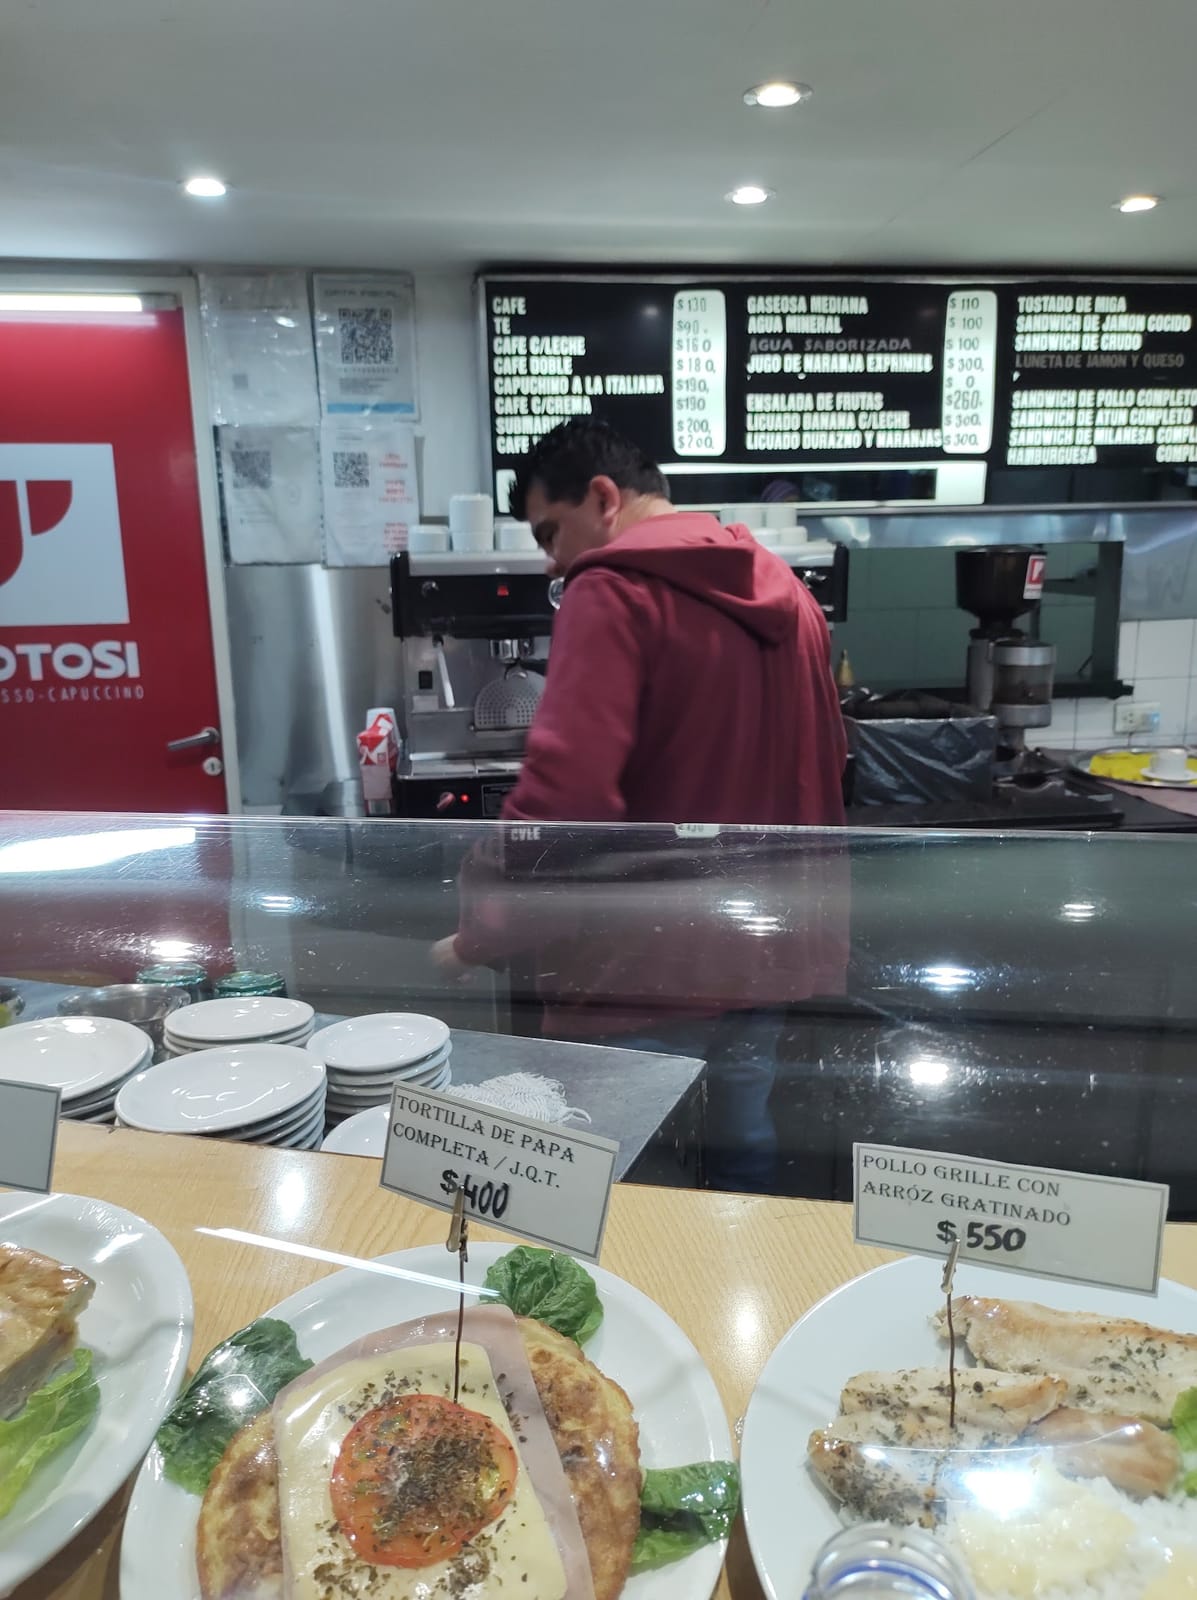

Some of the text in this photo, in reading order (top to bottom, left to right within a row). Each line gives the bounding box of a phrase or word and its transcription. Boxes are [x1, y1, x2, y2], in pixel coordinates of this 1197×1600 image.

[492, 297, 526, 315] CAFE
[748, 295, 868, 314] GASEOSA MEDIANA
[1017, 296, 1126, 313] TOSTADO DE MIGA
[493, 317, 511, 334] TE
[748, 315, 842, 334] AGUA MINERAL
[1016, 314, 1192, 332] SANDWICH DE JAMON COCIDO
[493, 336, 586, 356] CAFE C/LECHE
[750, 338, 912, 352] AGUA SABORIZADA
[1014, 333, 1142, 352] SANDWICH DE CRUDO
[494, 356, 573, 375] CAFE DOBLE
[747, 354, 782, 373] JUGO
[784, 354, 802, 373] DE
[803, 354, 864, 373] NARANJA
[1016, 353, 1184, 368] LUNETA DE JAMON Y QUESO
[494, 374, 664, 395] CAPUCHINO A LA ITALIANA
[494, 396, 592, 415] CAFE C/CREMA
[746, 392, 884, 412] ENSALADA DE FRUTAS
[1012, 390, 1078, 408] SANDWICH
[1078, 389, 1096, 408] DE
[1096, 389, 1136, 408] POLLO
[746, 410, 910, 432] LICUADO BANANA C/LECHE
[1011, 407, 1194, 428] SANDWICH DE ATUN COMPLETO
[496, 436, 530, 454] CAFE
[746, 429, 942, 450] LICUADO DURAZNO Y NARANJAS
[1009, 428, 1074, 446] SANDWICH
[1075, 427, 1093, 446] DE
[1094, 426, 1155, 445] MILANESA
[1007, 446, 1097, 466] HAMBURGUESA
[398, 1095, 575, 1163] TORTILLA DE PAPA
[393, 1122, 489, 1166] COMPLETA
[509, 1161, 560, 1188] J.Q.T.
[862, 1154, 1060, 1197] POLLO GRILLE CON
[941, 1193, 1070, 1226] GRATINADO
